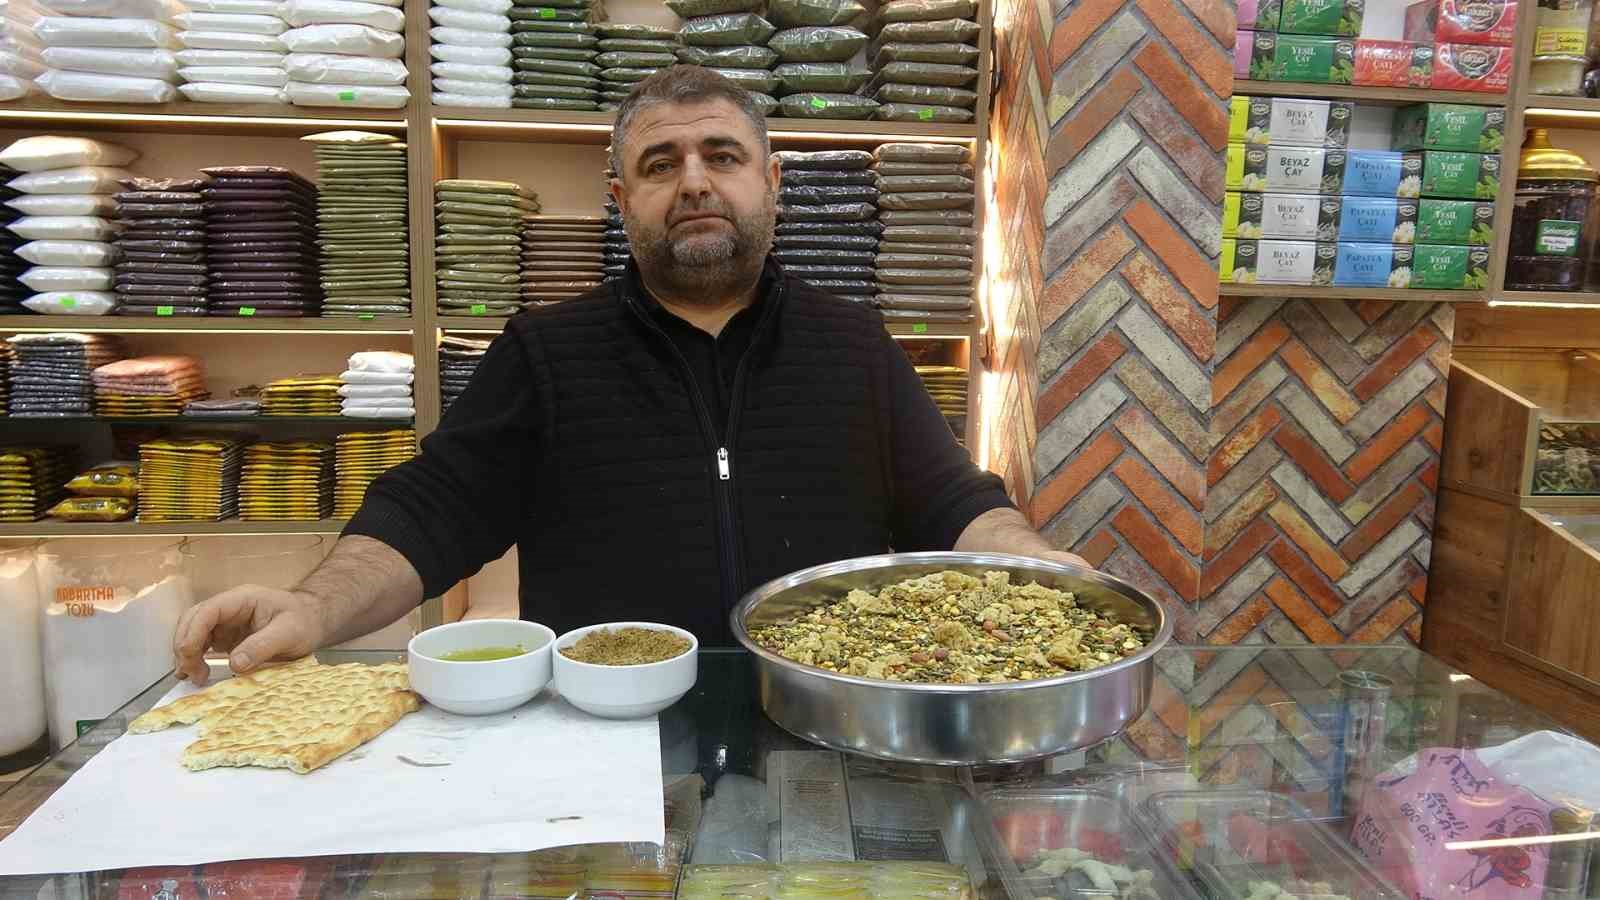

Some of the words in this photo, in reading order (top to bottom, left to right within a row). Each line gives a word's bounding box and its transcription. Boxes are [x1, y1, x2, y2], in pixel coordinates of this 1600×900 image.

[1280, 157, 1311, 167] BEYAZ
[1285, 167, 1303, 177] ÇAY
[1278, 204, 1305, 213] BEYAZ
[1273, 250, 1301, 259] BEYAZ
[65, 602, 96, 617] TOZU
